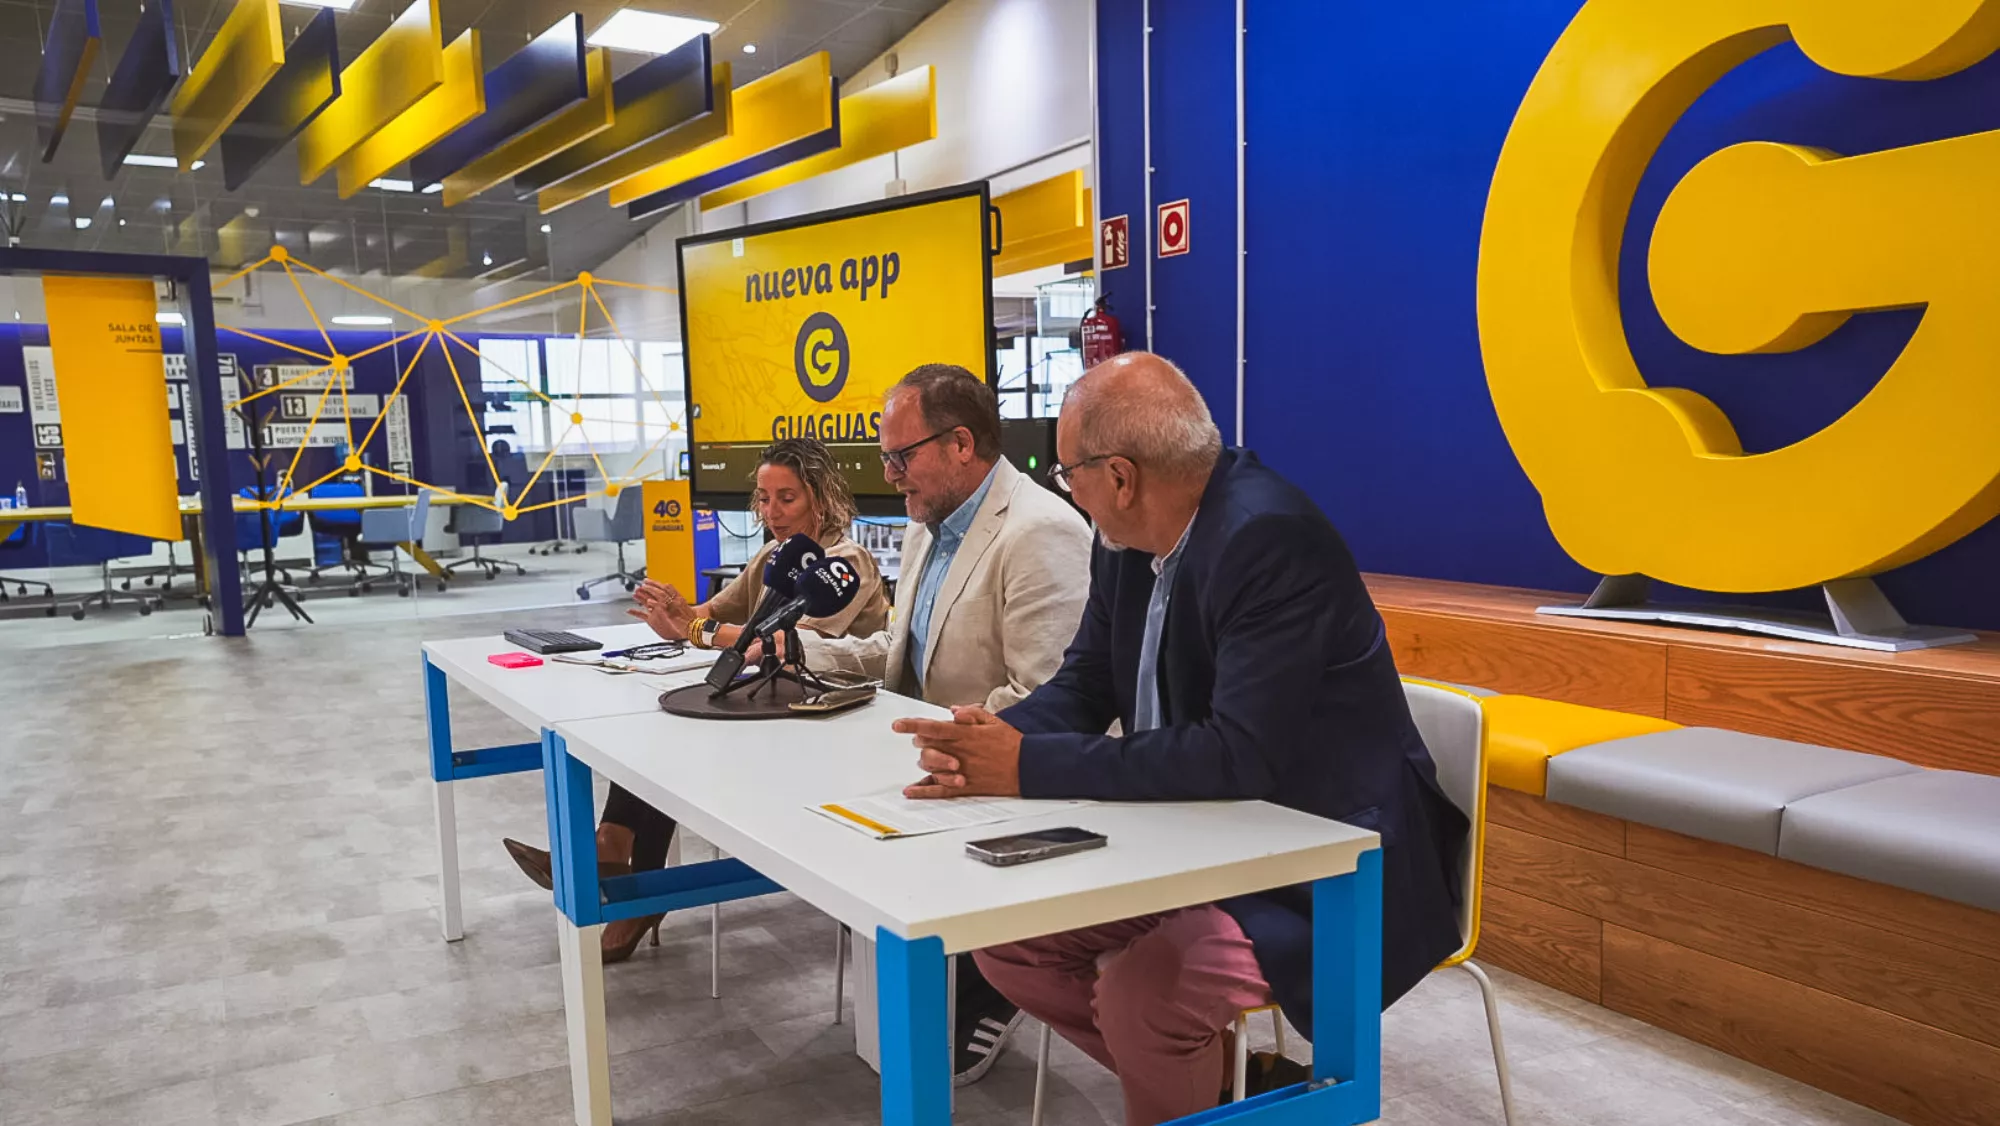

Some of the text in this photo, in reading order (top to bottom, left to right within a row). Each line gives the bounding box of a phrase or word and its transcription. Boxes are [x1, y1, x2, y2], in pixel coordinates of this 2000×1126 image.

[745, 252, 901, 303] nueva app
[108, 323, 153, 333] SALA DE
[114, 334, 155, 344] JUNTAS
[286, 397, 304, 416] 13
[37, 425, 62, 445] 55
[772, 411, 881, 442] GUAGUAS
[818, 567, 844, 598] CANARIAS
